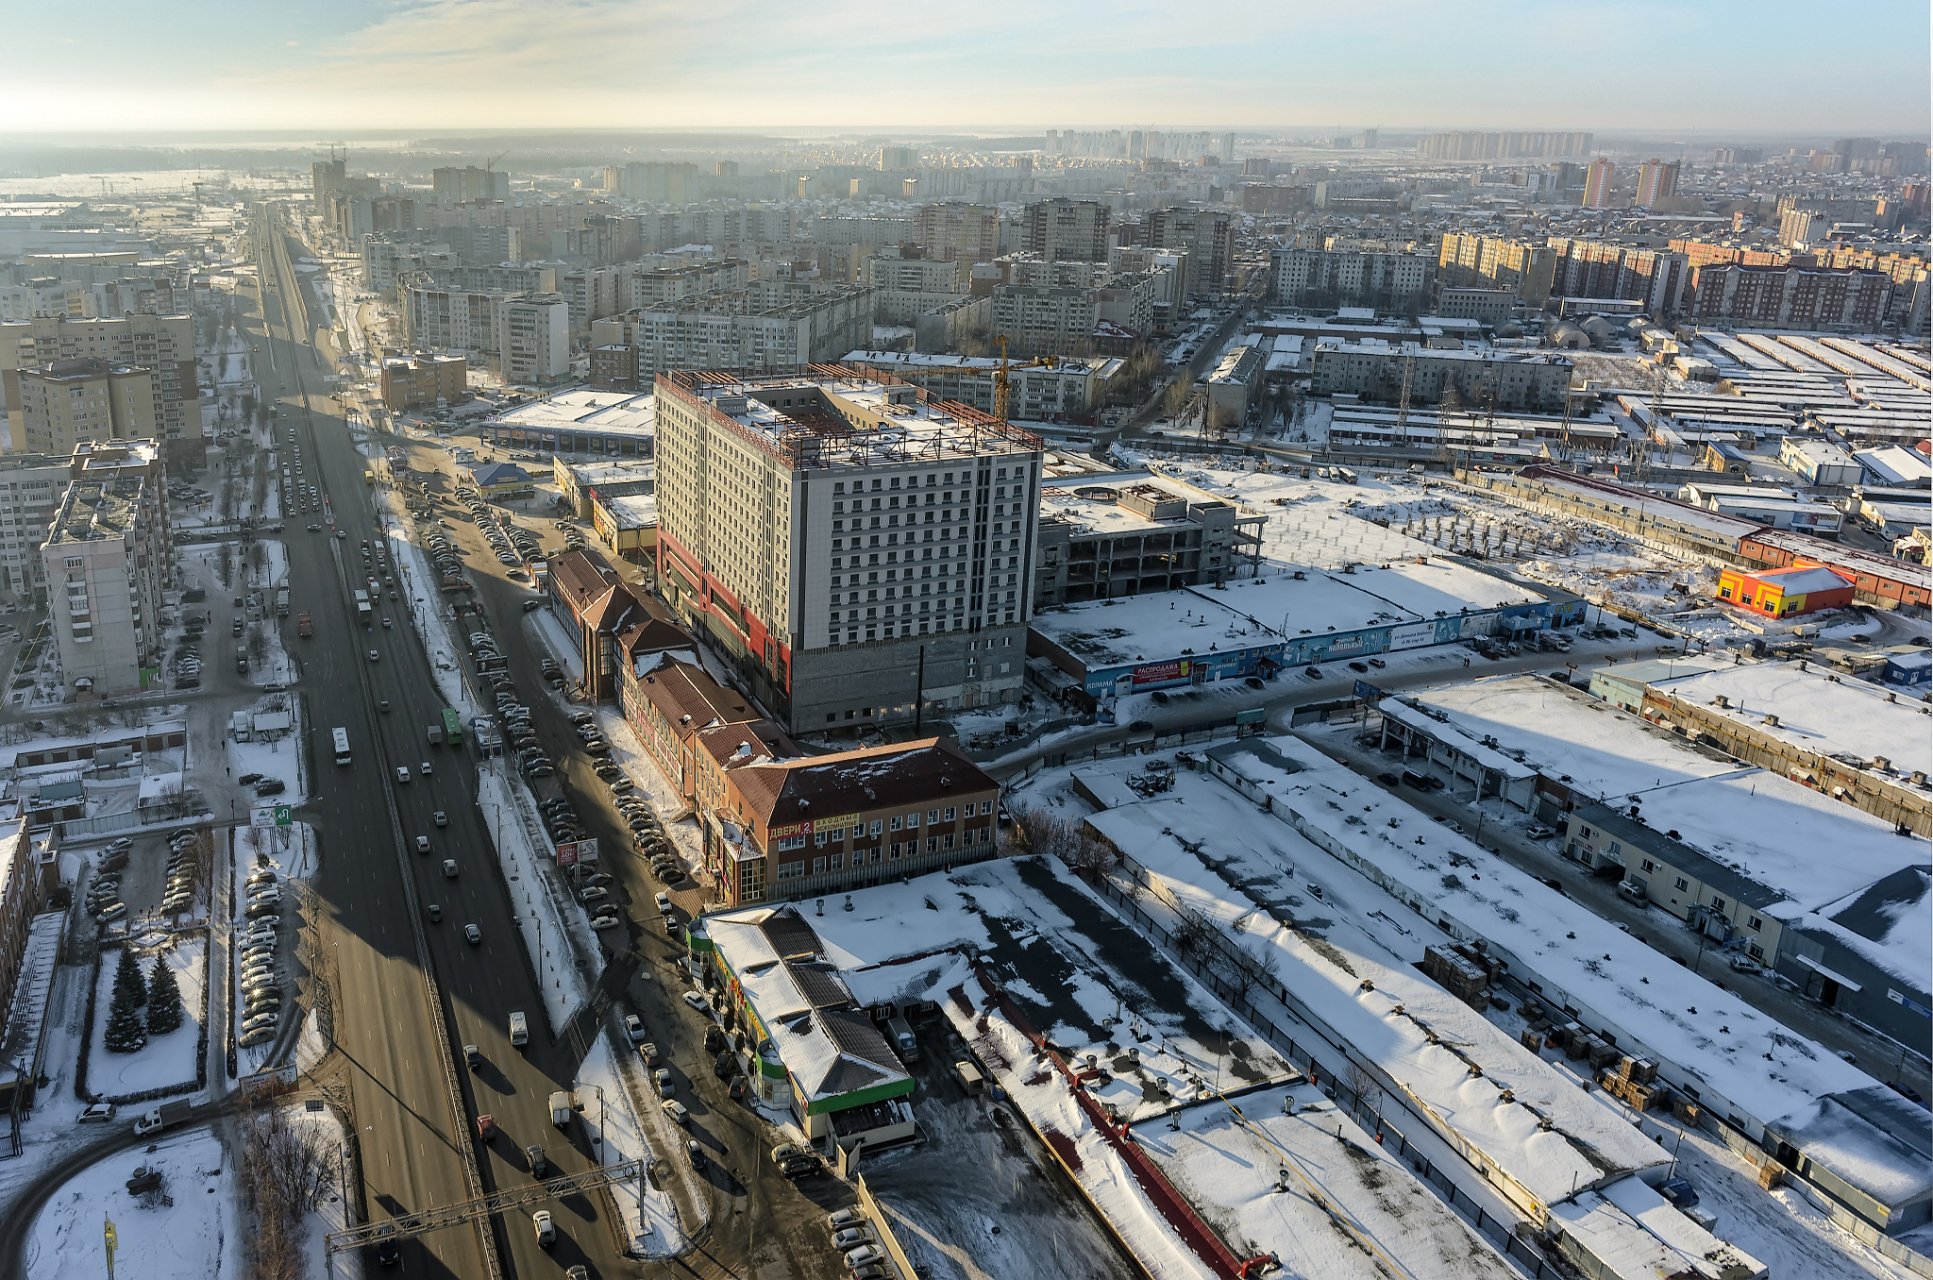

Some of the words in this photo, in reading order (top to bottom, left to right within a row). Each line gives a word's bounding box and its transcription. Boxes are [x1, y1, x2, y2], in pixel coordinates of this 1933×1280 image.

[1137, 663, 1178, 674] РАСПРОДАЖА
[815, 814, 858, 826] ВХОДНЫЕ
[769, 824, 801, 840] ДВЕРИ
